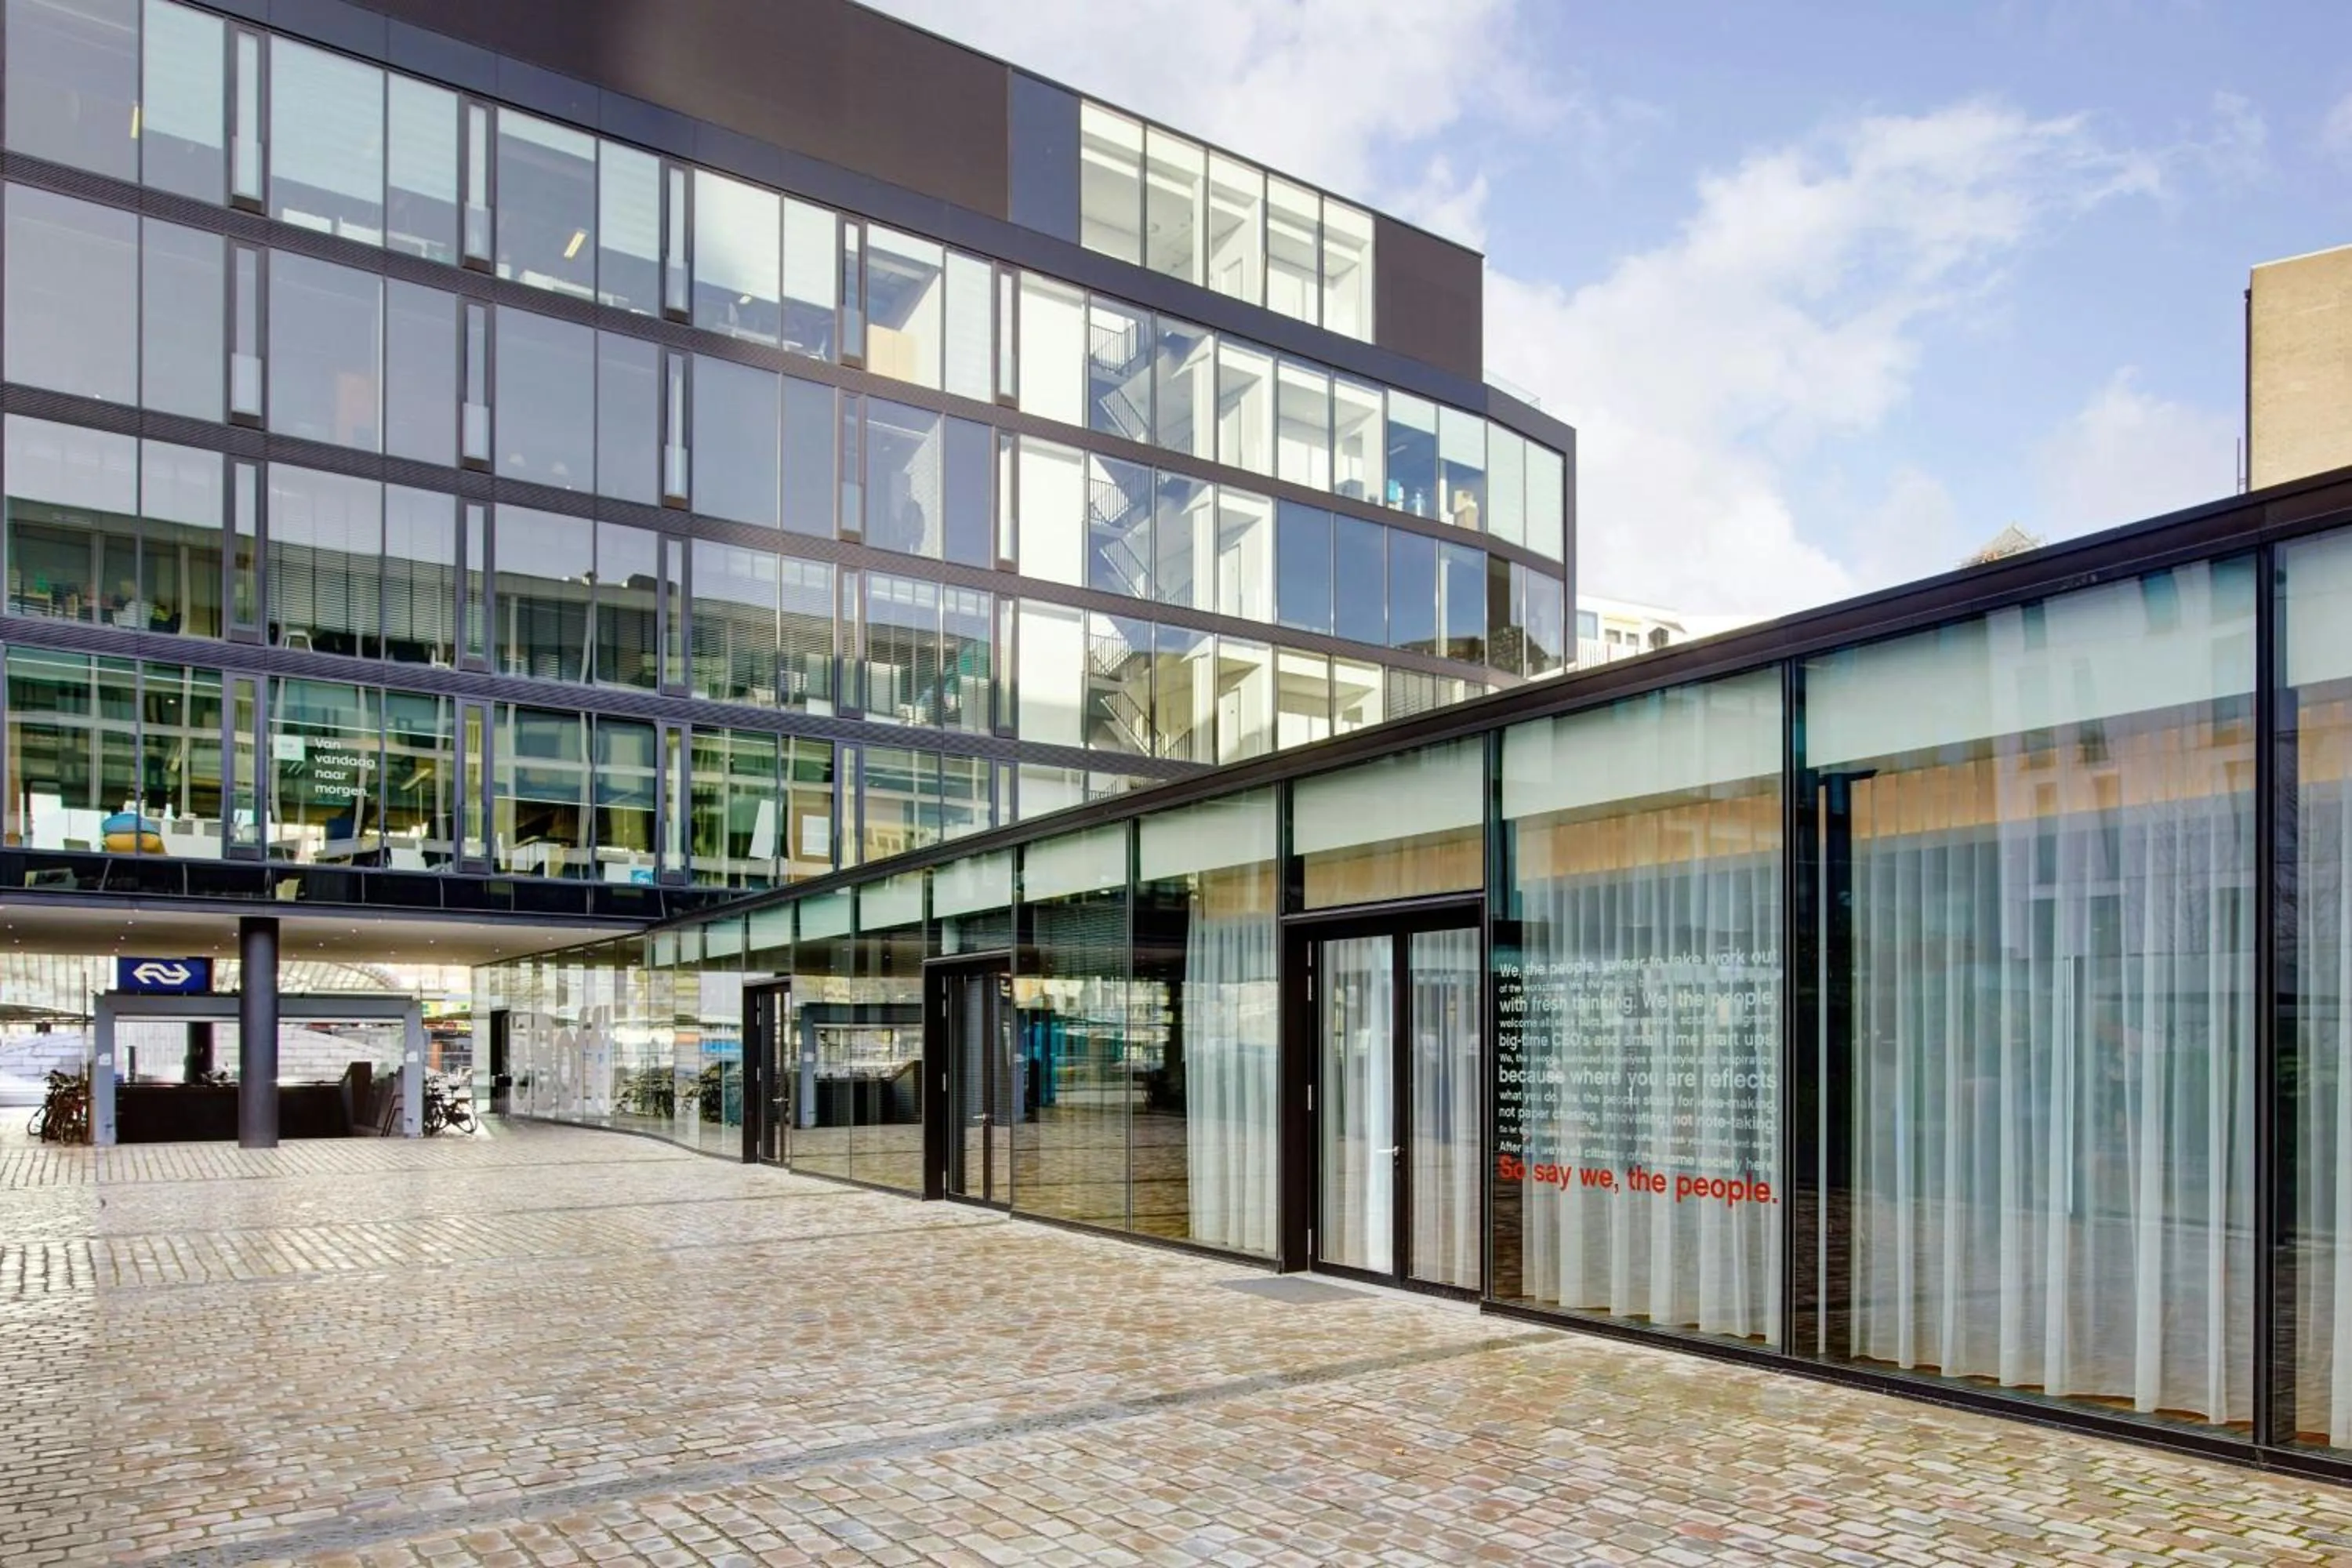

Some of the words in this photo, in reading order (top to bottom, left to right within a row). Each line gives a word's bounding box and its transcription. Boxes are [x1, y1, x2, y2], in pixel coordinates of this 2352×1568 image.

[314, 738, 340, 750] Van
[314, 753, 376, 770] vandaag
[314, 769, 347, 780] naar
[314, 784, 371, 798] morgen.
[1499, 963, 1521, 978] We,
[1524, 960, 1545, 975] the
[1650, 954, 1663, 967] to
[1668, 951, 1702, 966] take
[1707, 947, 1745, 965] work
[1751, 948, 1777, 964] out
[1499, 996, 1527, 1012] with
[1532, 996, 1567, 1011] fresh
[1573, 993, 1637, 1014] thinking.
[1678, 989, 1704, 1007] the
[1499, 1018, 1537, 1028] welcome
[1499, 1033, 1548, 1050] big-time
[1552, 1031, 1590, 1047] CEO's
[1594, 1032, 1620, 1047] and
[1624, 1031, 1661, 1047] small
[1704, 1031, 1739, 1047] start
[1499, 1065, 1565, 1083] because
[1570, 1066, 1621, 1085] where
[1627, 1071, 1658, 1093] you
[1666, 1071, 1696, 1087] are
[1703, 1068, 1777, 1089] reflects
[1499, 1089, 1521, 1101] what
[1584, 1091, 1599, 1103] the
[1679, 1094, 1693, 1107] for
[1499, 1106, 1515, 1117] not
[1518, 1109, 1549, 1121] paper
[1673, 1114, 1693, 1126] not
[1499, 1141, 1522, 1152] After
[1498, 1154, 1526, 1180] So
[1534, 1163, 1572, 1192] say
[1579, 1167, 1620, 1194] we,
[1627, 1164, 1667, 1194] the
[1675, 1170, 1778, 1208] people.
